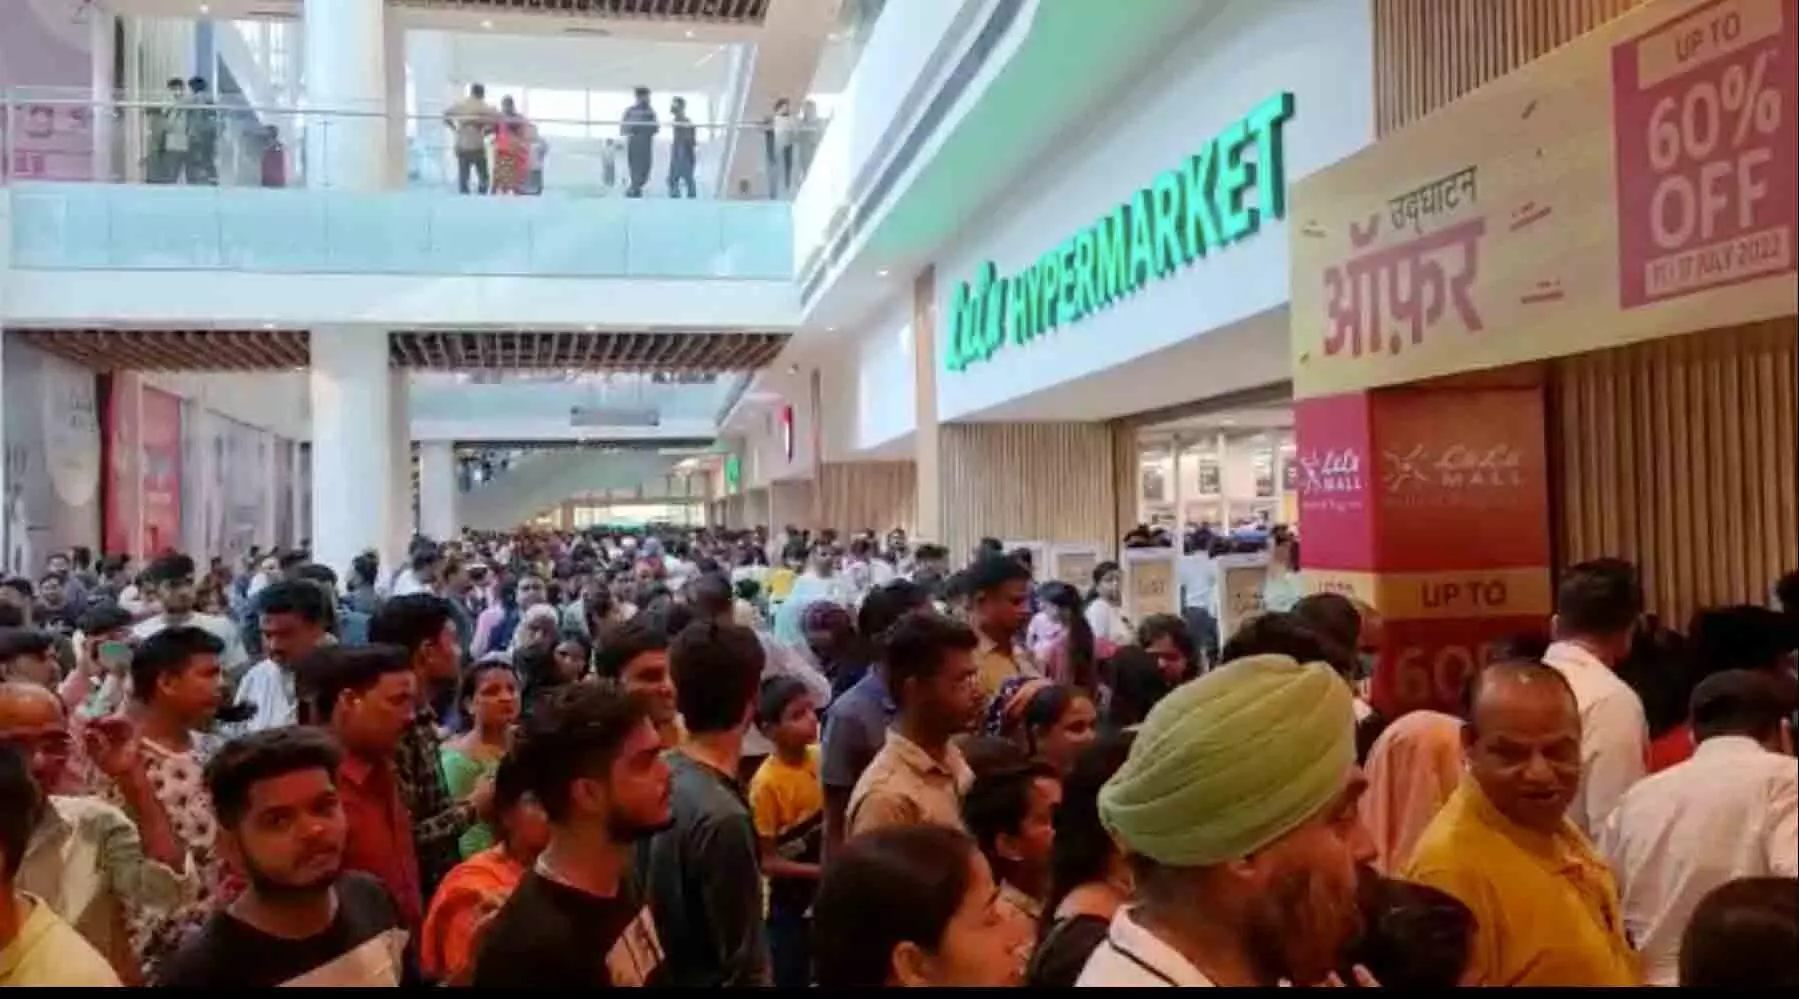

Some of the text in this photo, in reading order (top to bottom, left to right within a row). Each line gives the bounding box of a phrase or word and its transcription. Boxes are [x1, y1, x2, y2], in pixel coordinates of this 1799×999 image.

[1674, 12, 1741, 63] UP TO
[1010, 90, 1294, 346] HYPERMARKET
[1650, 147, 1772, 249] OFF
[1698, 245, 1733, 275] JULY
[1323, 476, 1362, 492] MALL
[1441, 470, 1523, 488] MALL
[1421, 578, 1508, 608] UP TO
[1395, 645, 1491, 704] 60
